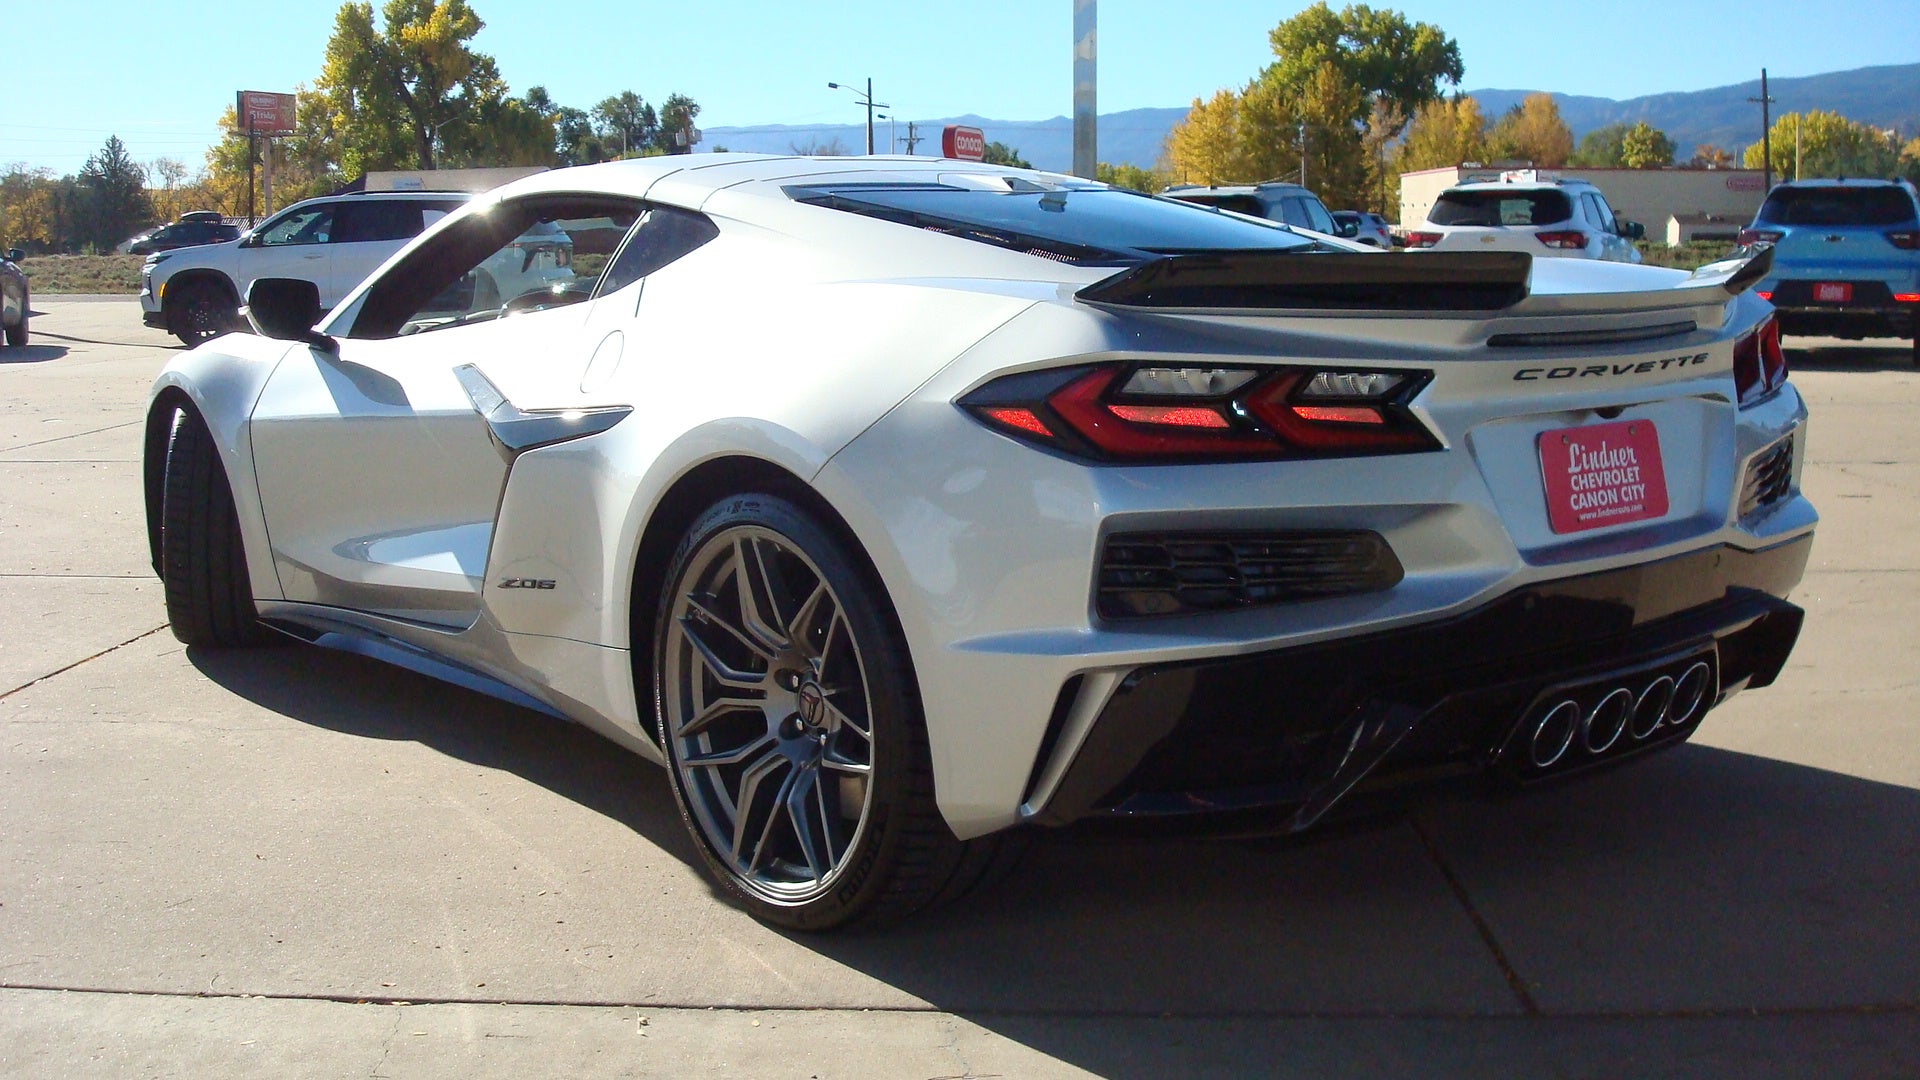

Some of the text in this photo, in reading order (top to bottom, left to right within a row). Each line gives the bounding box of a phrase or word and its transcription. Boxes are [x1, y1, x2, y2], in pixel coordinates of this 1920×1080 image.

[1513, 352, 1709, 381] CORVETTE
[1568, 440, 1638, 474] Lindner
[1570, 466, 1640, 491] CHEVROLET
[1570, 483, 1645, 511] CANON CITY
[497, 577, 557, 590] Z06
